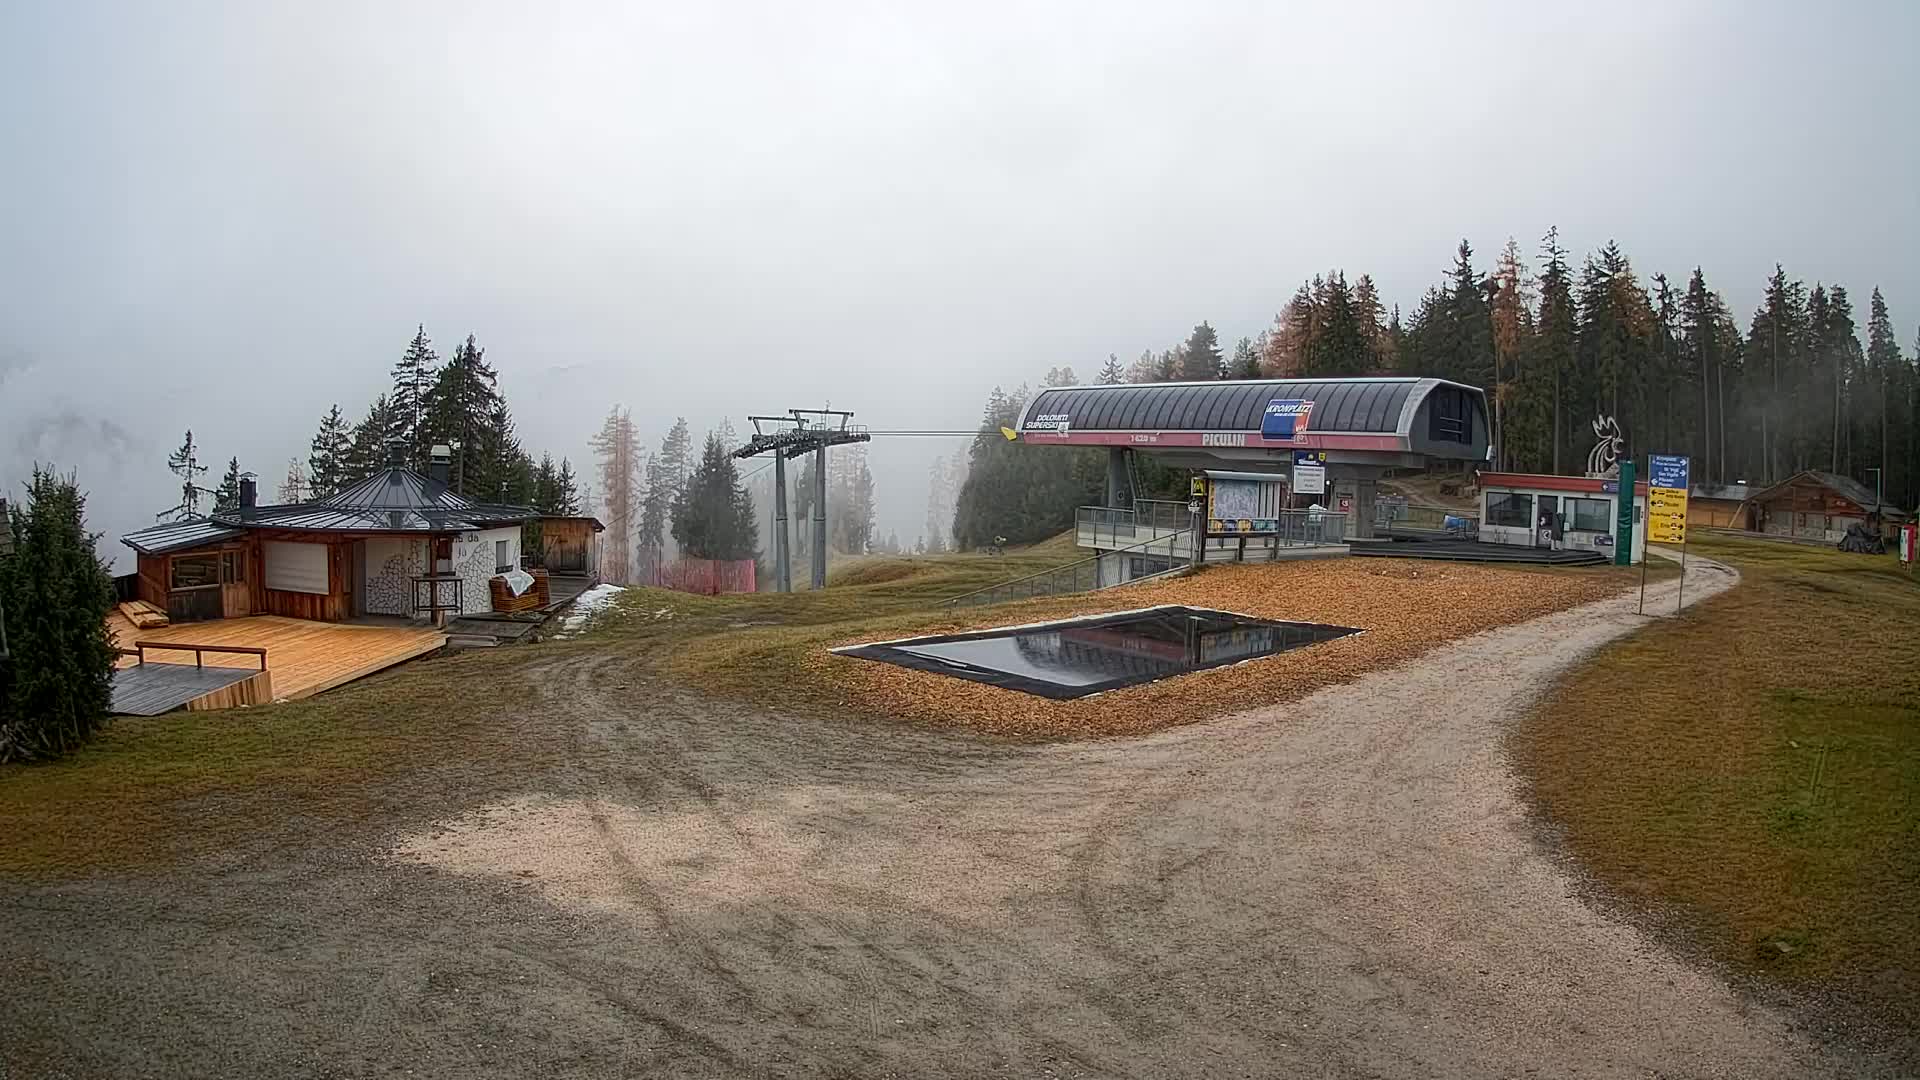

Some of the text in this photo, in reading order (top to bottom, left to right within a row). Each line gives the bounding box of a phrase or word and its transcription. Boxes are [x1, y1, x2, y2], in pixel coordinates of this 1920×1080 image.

[1266, 404, 1310, 413] KRONPLATZ
[1025, 421, 1059, 429] SUPERSKI
[1202, 433, 1245, 447] PICULIN
